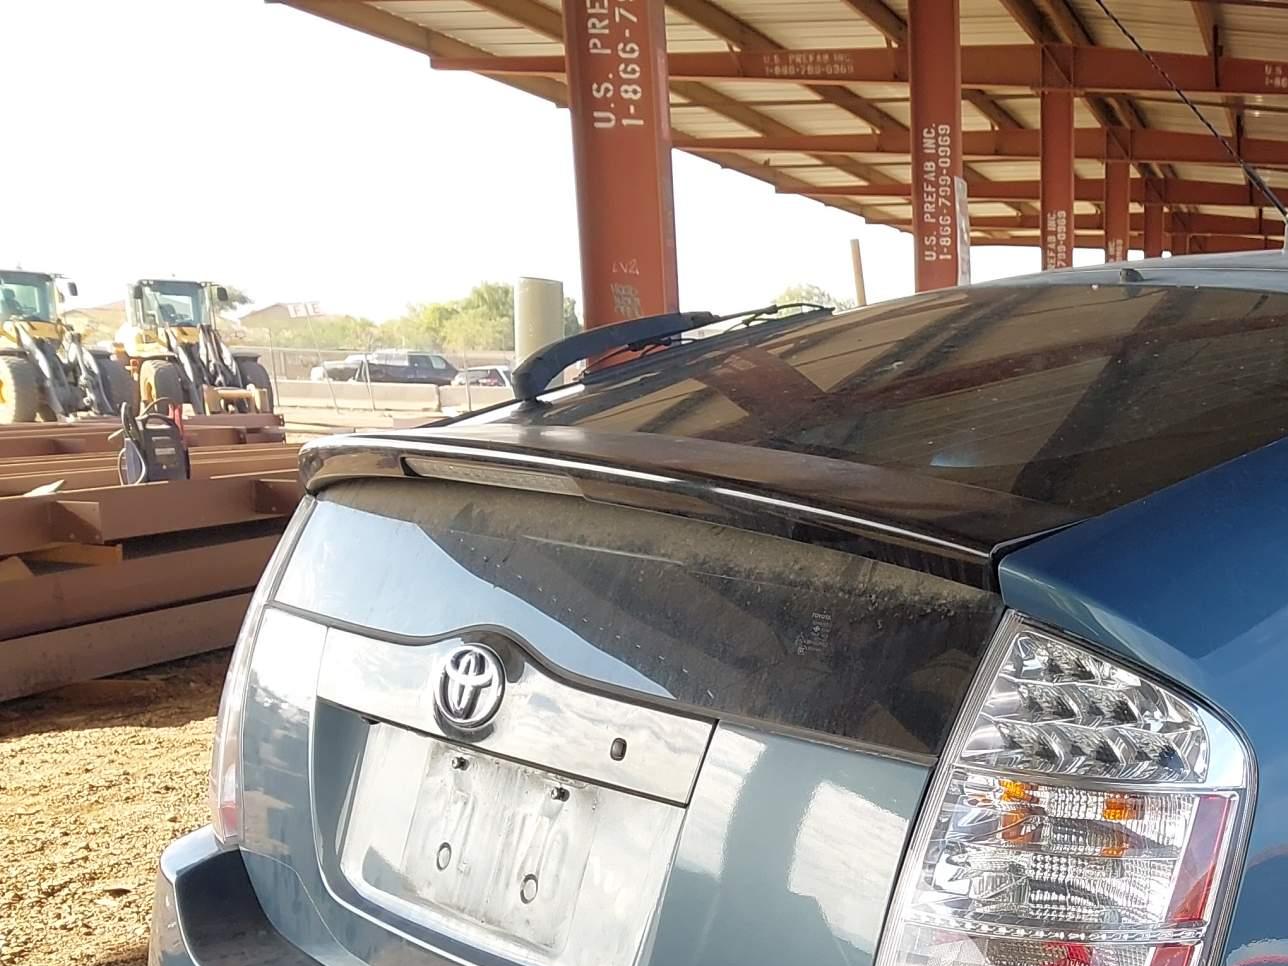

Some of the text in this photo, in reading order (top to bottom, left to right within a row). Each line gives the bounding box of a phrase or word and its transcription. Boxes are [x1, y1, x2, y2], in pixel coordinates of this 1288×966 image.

[591, 73, 616, 129] U.S.
[614, 0, 645, 126] 1-866-7
[922, 123, 937, 261] U.S. PREFAB INC.
[938, 124, 952, 260] 1-866-799-0969
